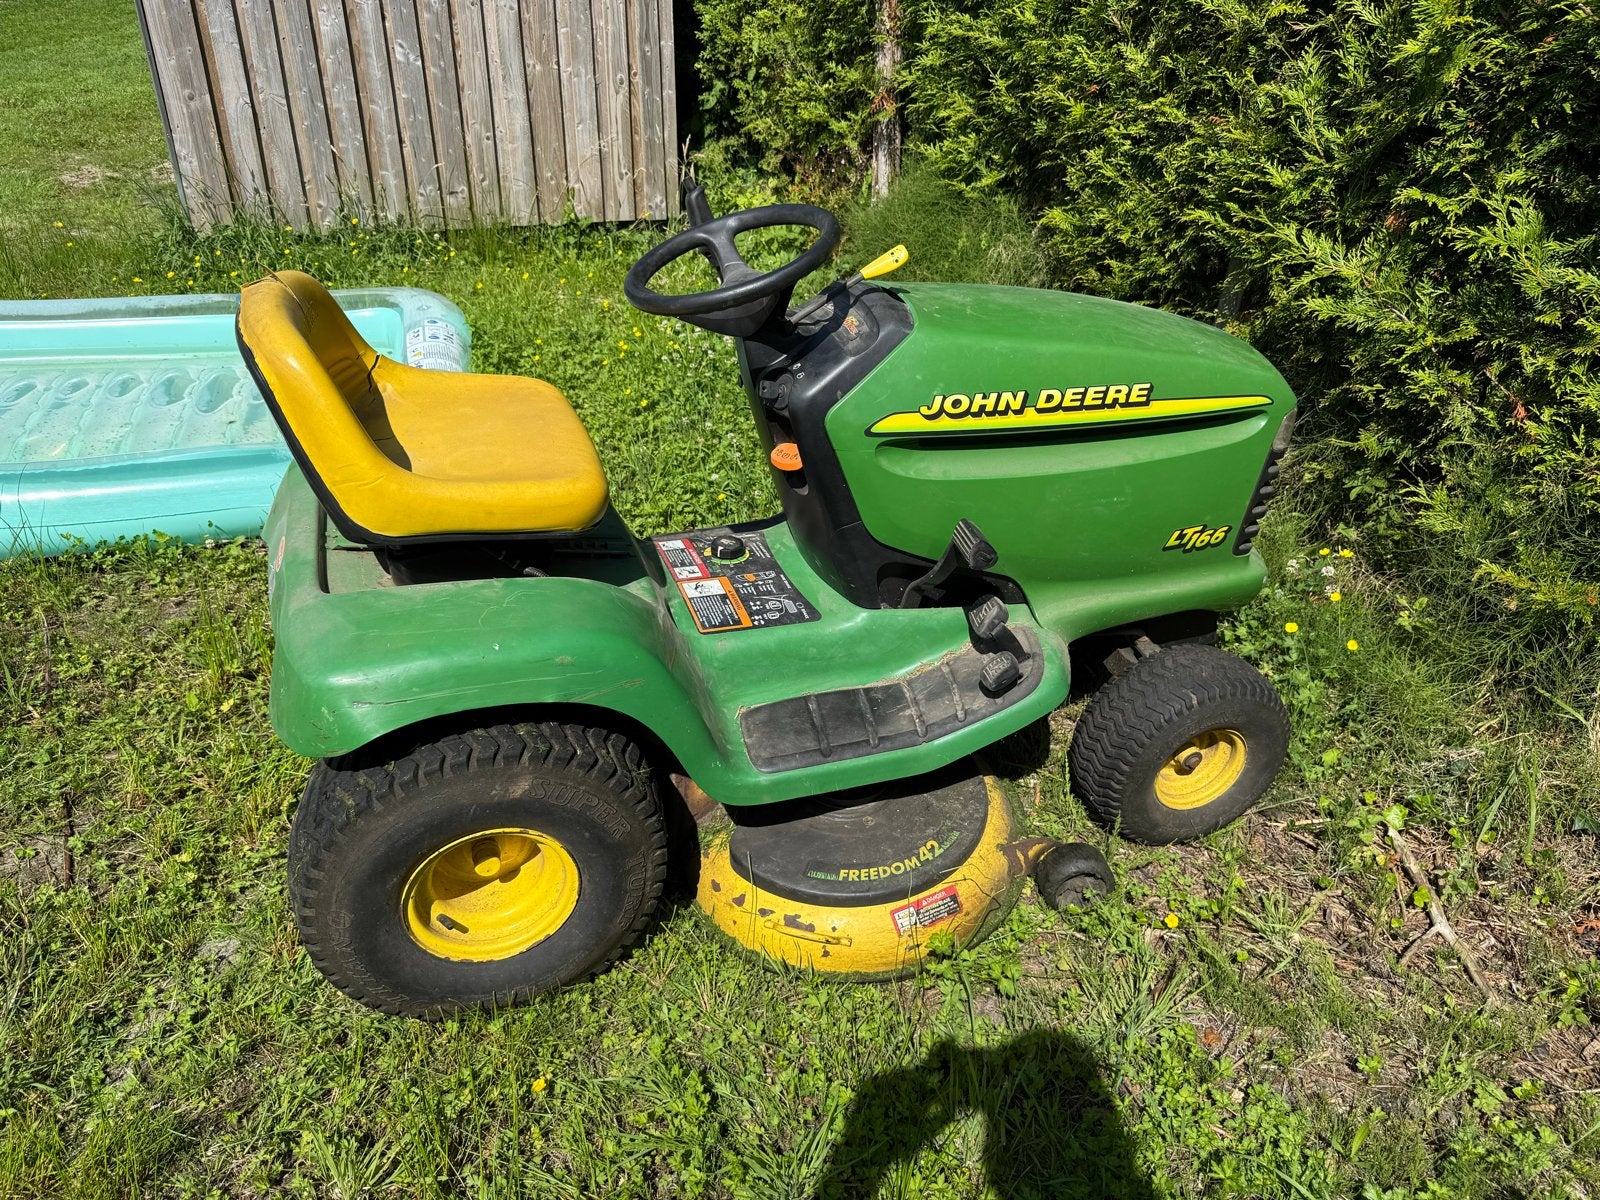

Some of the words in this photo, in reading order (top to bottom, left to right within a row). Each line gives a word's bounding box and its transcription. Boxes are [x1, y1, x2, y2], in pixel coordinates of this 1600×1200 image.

[918, 390, 1028, 420] JOHN
[1034, 383, 1154, 413] DEERE
[1163, 524, 1231, 552] LT166
[730, 593, 743, 611] WARNING
[528, 778, 631, 840] SUPER
[618, 847, 647, 931] TURF
[926, 890, 947, 904] DANGER
